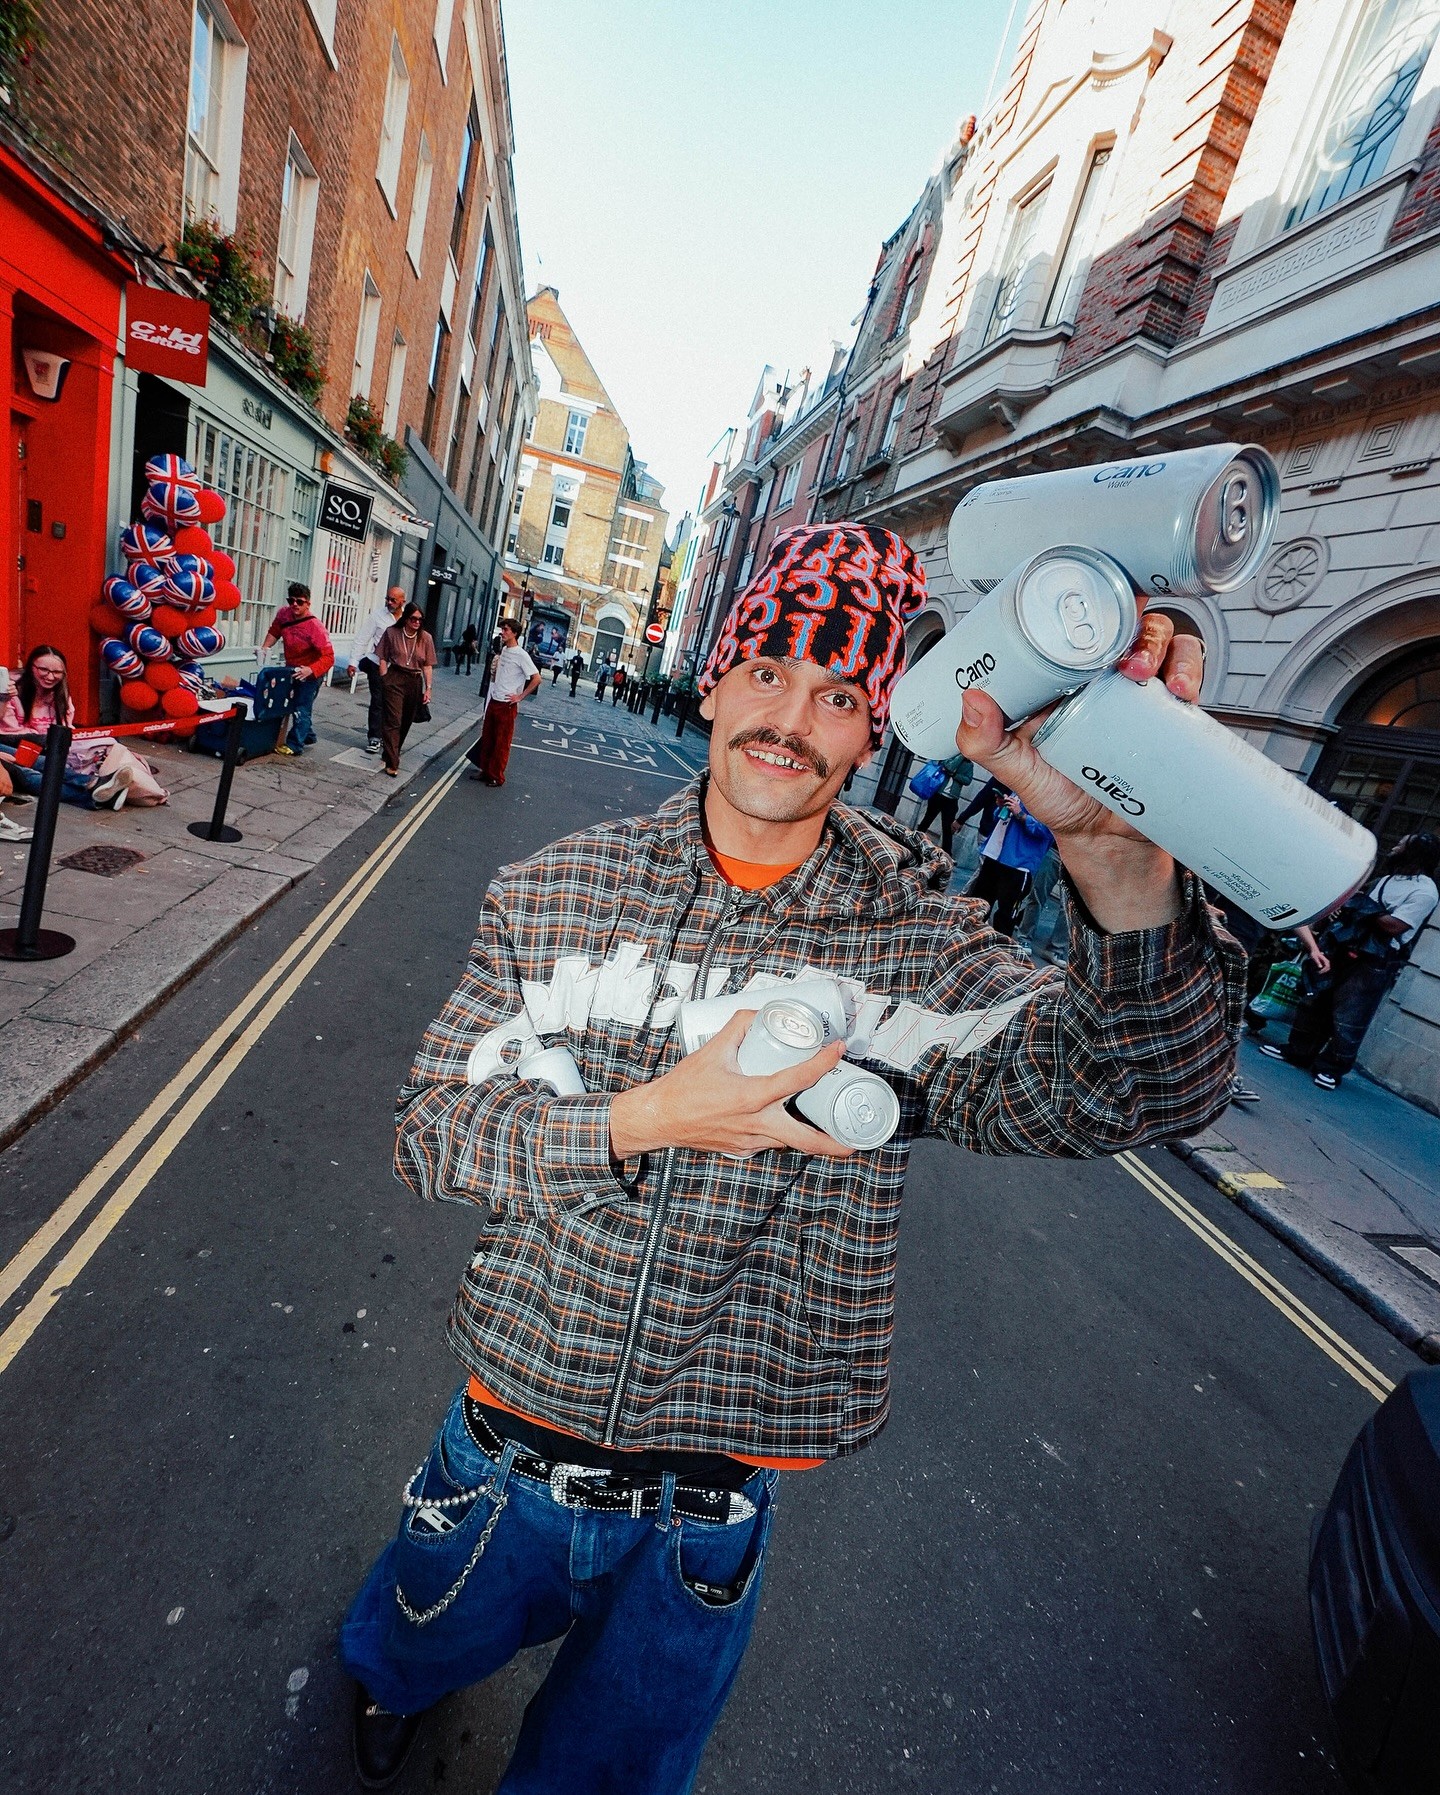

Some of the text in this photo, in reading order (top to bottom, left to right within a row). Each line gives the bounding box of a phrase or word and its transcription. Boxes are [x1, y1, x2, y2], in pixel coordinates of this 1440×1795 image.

[130, 331, 201, 355] culture
[1093, 462, 1167, 484] Cano
[1107, 479, 1133, 490] Water
[955, 652, 997, 690] Cano
[531, 719, 657, 753] CLEAR
[541, 737, 659, 768] KEEP
[1081, 766, 1146, 817] Cano
[1110, 774, 1135, 794] Water
